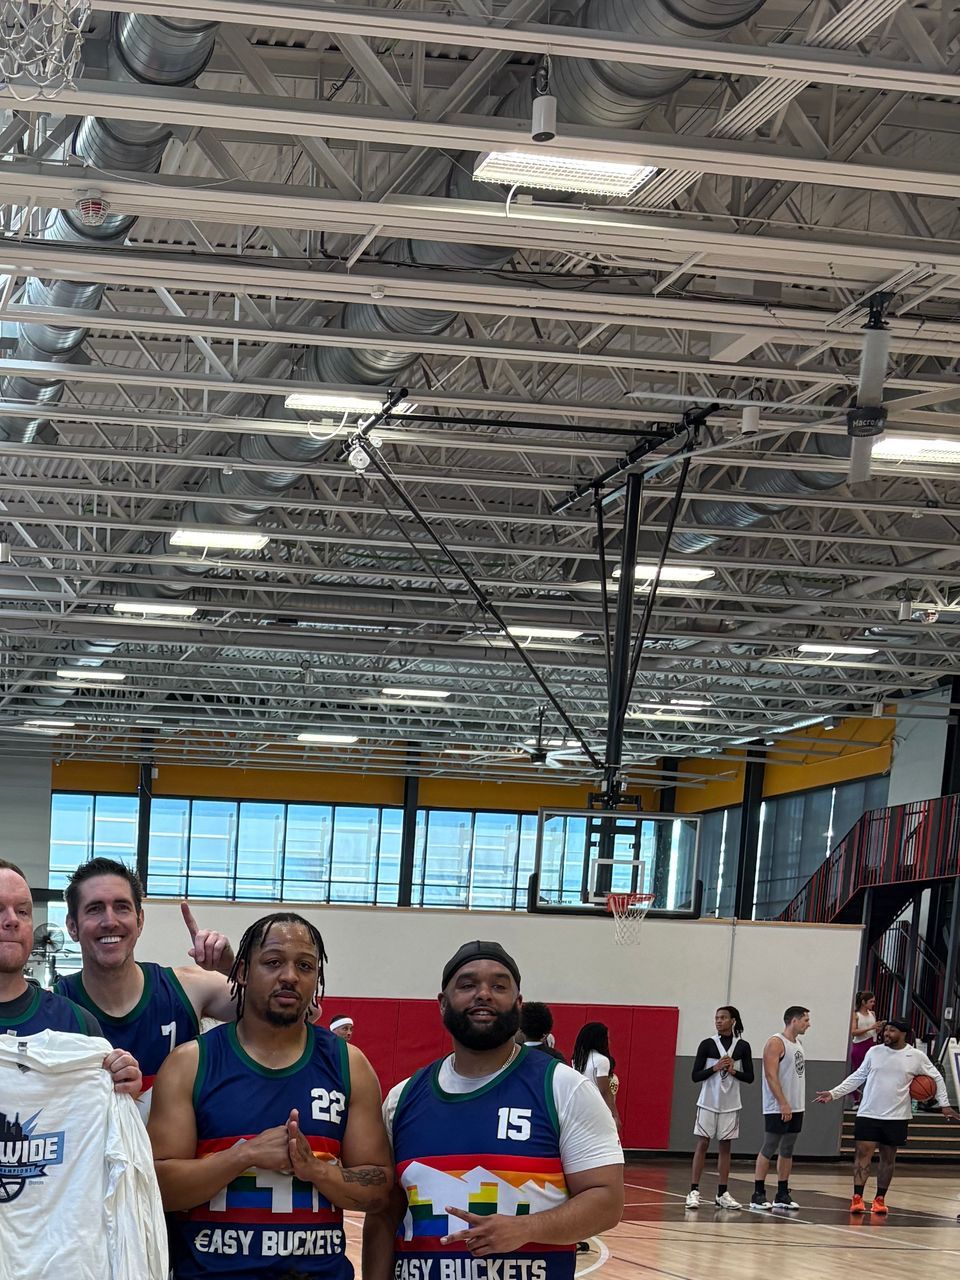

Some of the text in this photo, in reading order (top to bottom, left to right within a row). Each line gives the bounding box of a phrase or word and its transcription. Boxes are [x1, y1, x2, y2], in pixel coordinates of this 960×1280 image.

[161, 1021, 176, 1051] 7
[310, 1087, 346, 1124] 22
[497, 1107, 532, 1141] 15
[261, 1229, 342, 1257] BUCKETS
